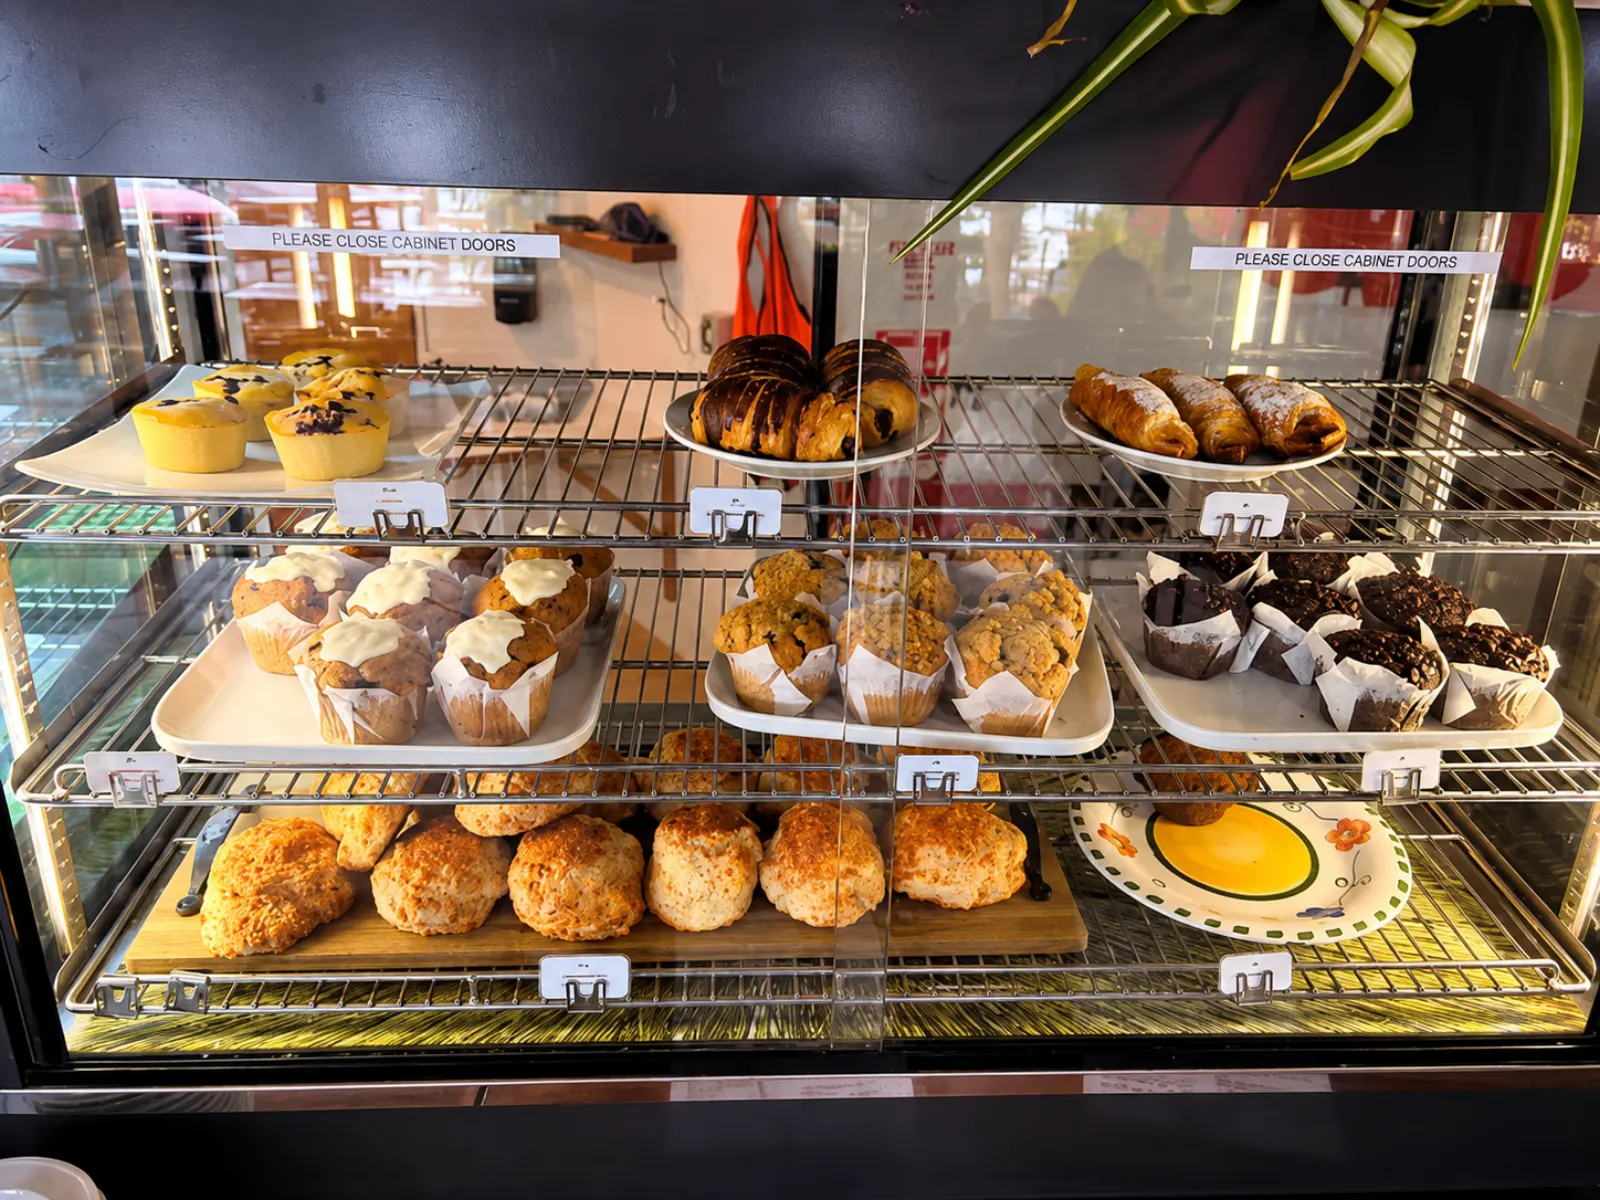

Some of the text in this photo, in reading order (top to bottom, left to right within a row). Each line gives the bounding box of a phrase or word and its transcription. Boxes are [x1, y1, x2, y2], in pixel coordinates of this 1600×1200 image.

[272, 232, 516, 252] PLEASE CLOSE CABINET DOORS
[1235, 252, 1458, 269] PLEASE CLOSE CABINET DOORS
